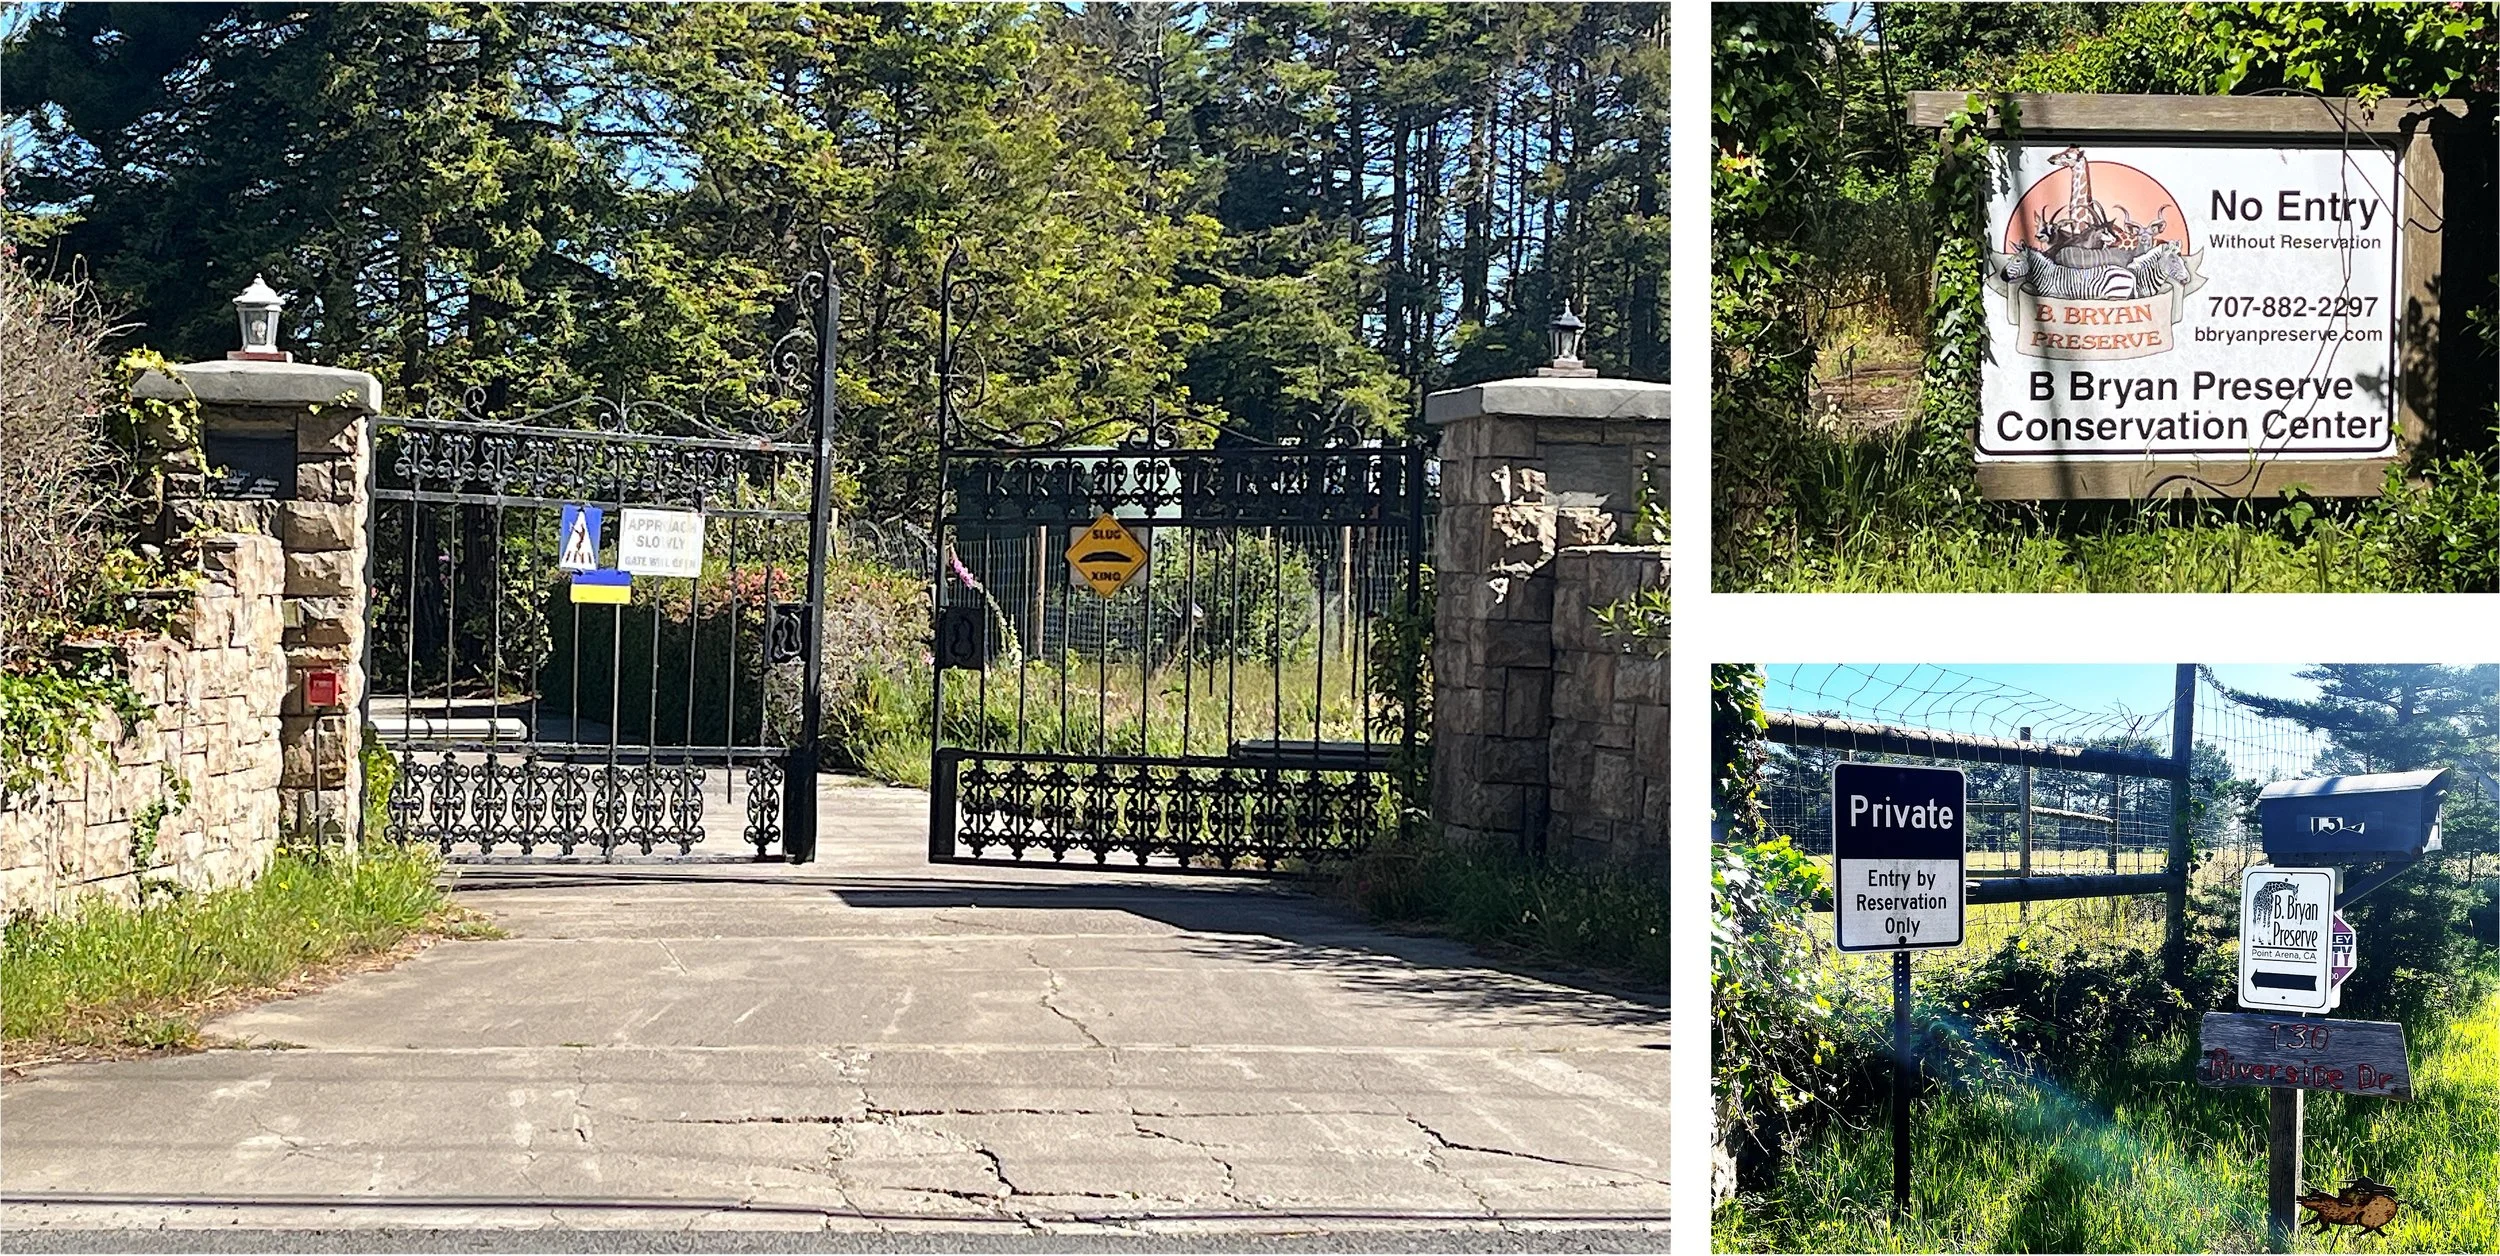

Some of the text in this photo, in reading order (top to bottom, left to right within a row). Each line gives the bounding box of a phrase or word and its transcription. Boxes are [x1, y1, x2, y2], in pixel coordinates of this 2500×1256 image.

[2211, 190, 2379, 230] No Entry
[2210, 234, 2381, 249] Without Reservation
[2035, 303, 2153, 325] B. BRYAN
[2209, 296, 2378, 317] 707-882-2297
[2031, 330, 2162, 350] PRESERVE
[2195, 326, 2382, 345] bbryanpreservecom
[2030, 371, 2352, 409] B Bryan Preserve
[1997, 409, 2382, 441] Conservation Center
[628, 519, 697, 533] APPRACH
[1092, 529, 1121, 539] SLUG
[625, 556, 647, 566] GATE
[649, 557, 670, 568] WIL
[1092, 572, 1121, 581] XING
[1850, 795, 1954, 829] Private
[1868, 870, 1936, 890] Entry by
[1856, 894, 1947, 911] Reservation
[2274, 895, 2318, 925] B. Bryan
[1885, 917, 1920, 937] Only
[2273, 921, 2318, 947] Preserve
[2333, 935, 2352, 944] EY
[2251, 949, 2317, 960] Point Arena, CA
[2269, 1023, 2330, 1052] 130
